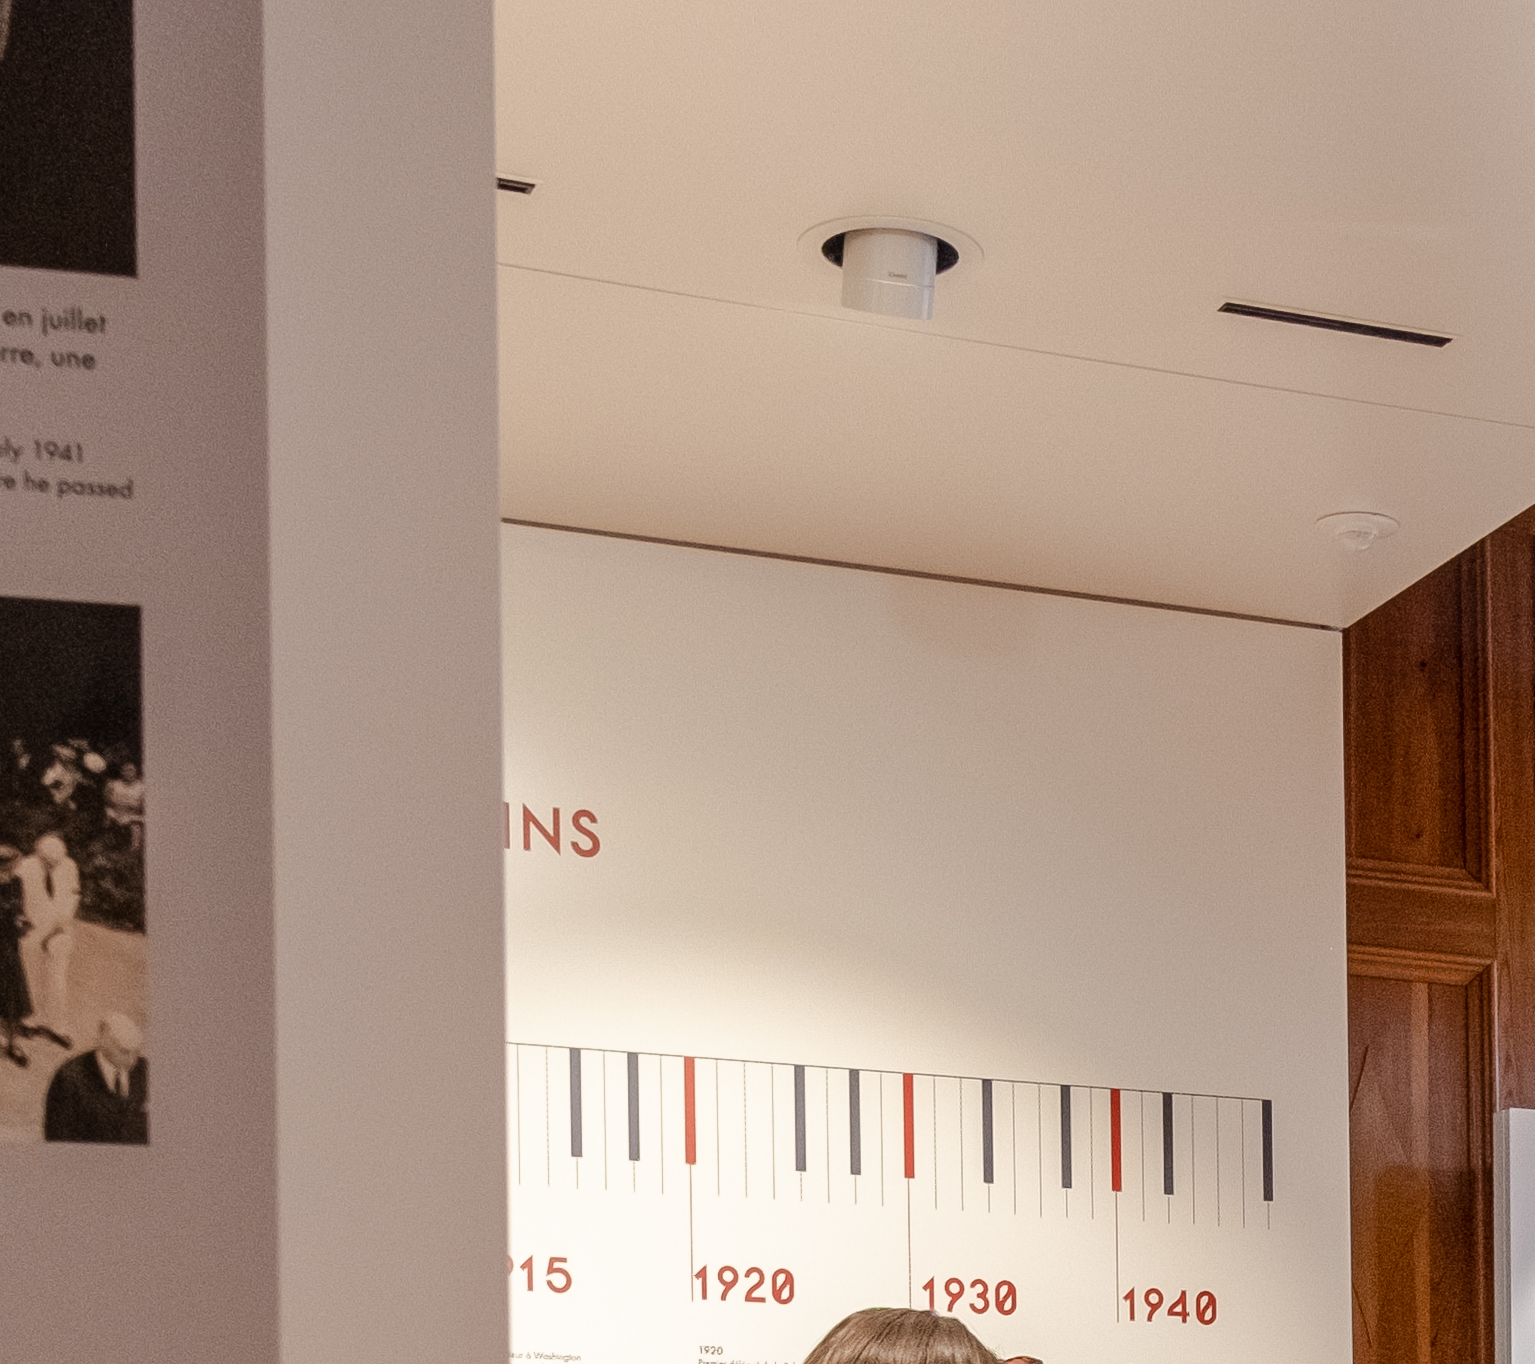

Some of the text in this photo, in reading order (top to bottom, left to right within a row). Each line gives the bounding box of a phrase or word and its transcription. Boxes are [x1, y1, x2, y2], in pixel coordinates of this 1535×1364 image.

[1, 309, 33, 327] en
[41, 307, 107, 335] juillet
[50, 351, 97, 371] une
[508, 1254, 572, 1294] 15
[693, 1264, 794, 1305] 1920
[922, 1276, 1017, 1316] 1930
[1122, 1286, 1217, 1325] 1940
[699, 1345, 723, 1355] 1920
